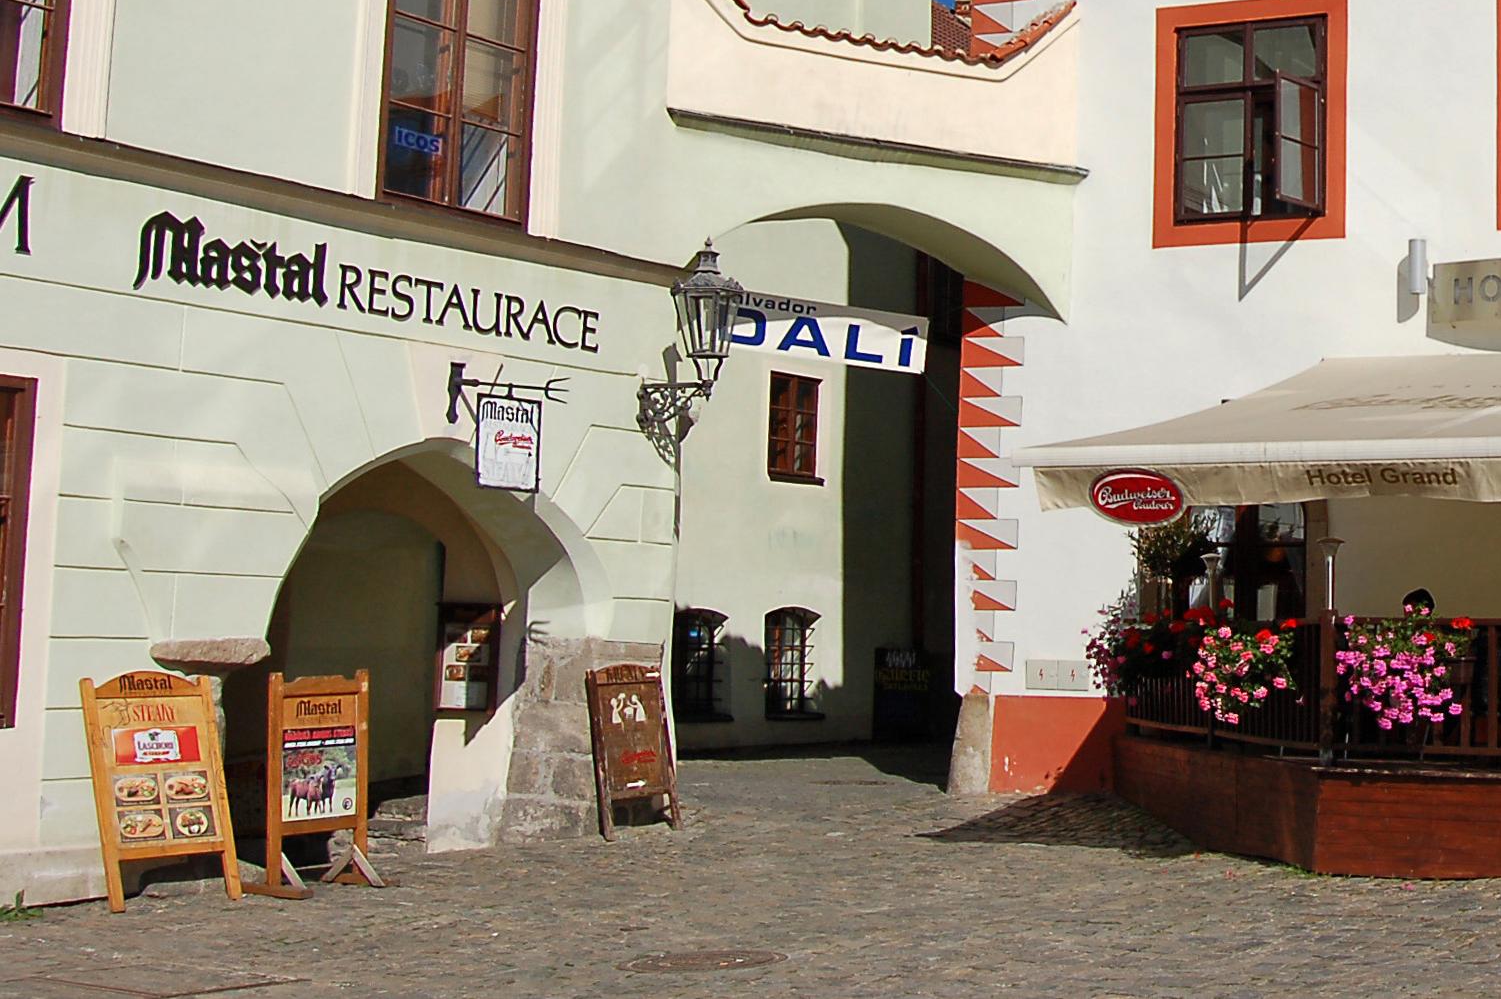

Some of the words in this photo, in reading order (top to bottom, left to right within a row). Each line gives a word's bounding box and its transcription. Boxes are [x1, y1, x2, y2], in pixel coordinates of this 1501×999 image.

[133, 211, 329, 308] Maštal
[336, 264, 600, 353] RESTAURACE
[737, 291, 817, 315] lvador
[719, 306, 919, 368] DALÍ
[1306, 467, 1373, 486] Hotel
[1379, 467, 1458, 485] Grand
[1098, 486, 1174, 506] Budweiser
[1132, 498, 1174, 510] Budvar
